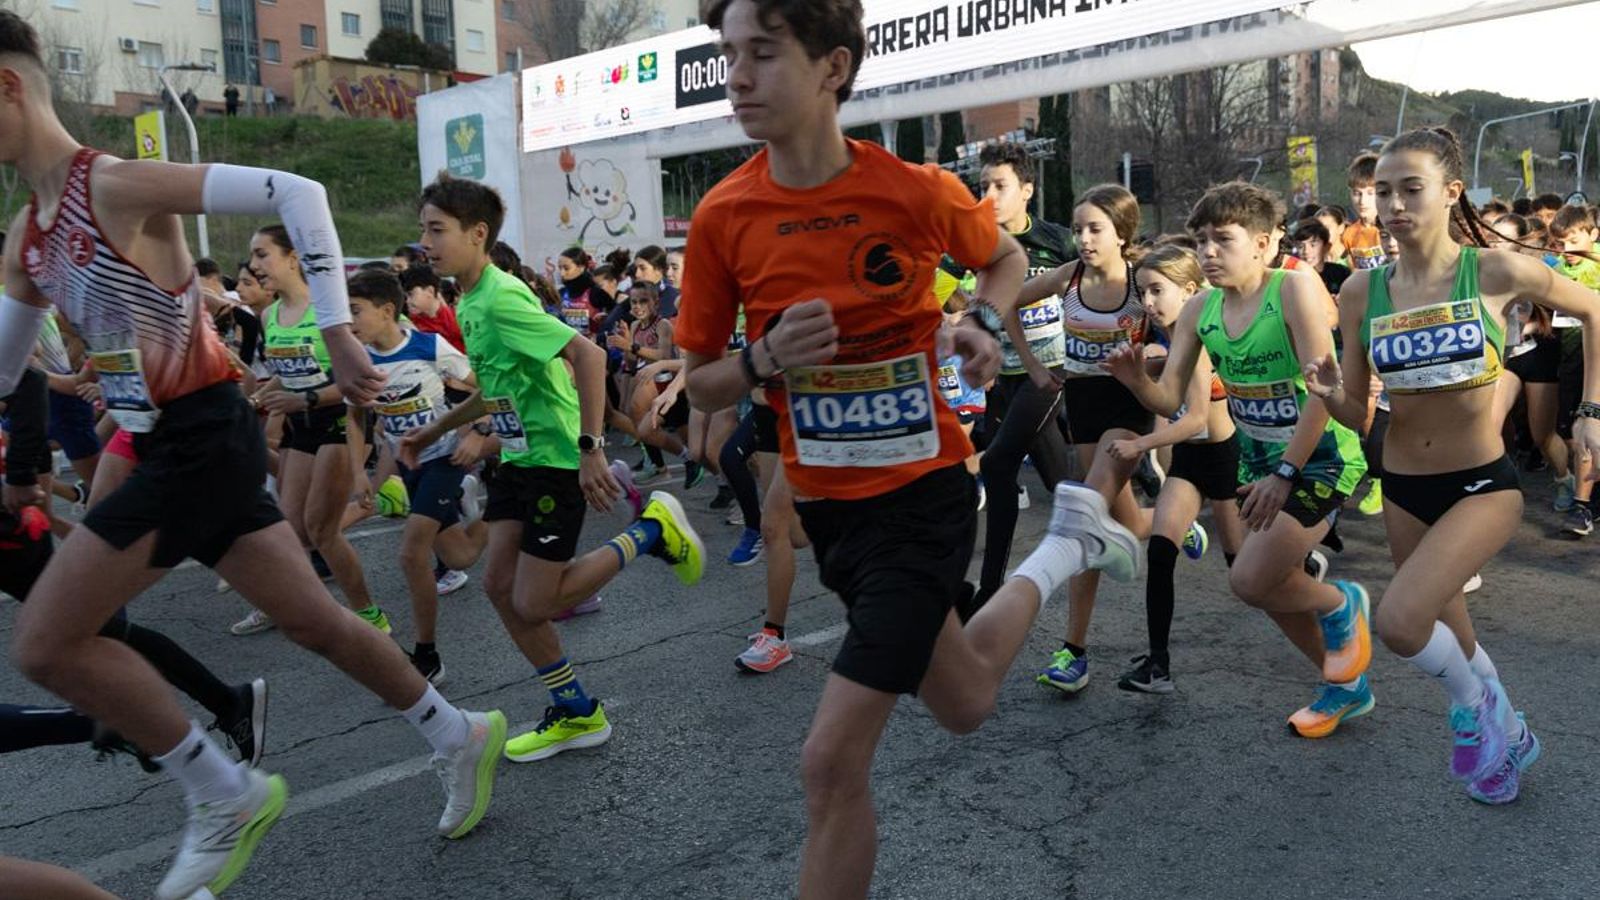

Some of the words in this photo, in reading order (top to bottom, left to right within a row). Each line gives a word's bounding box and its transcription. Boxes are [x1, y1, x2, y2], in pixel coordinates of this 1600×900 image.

[681, 55, 727, 93] 00:00
[1375, 323, 1481, 363] 10329
[794, 387, 929, 429] 10483
